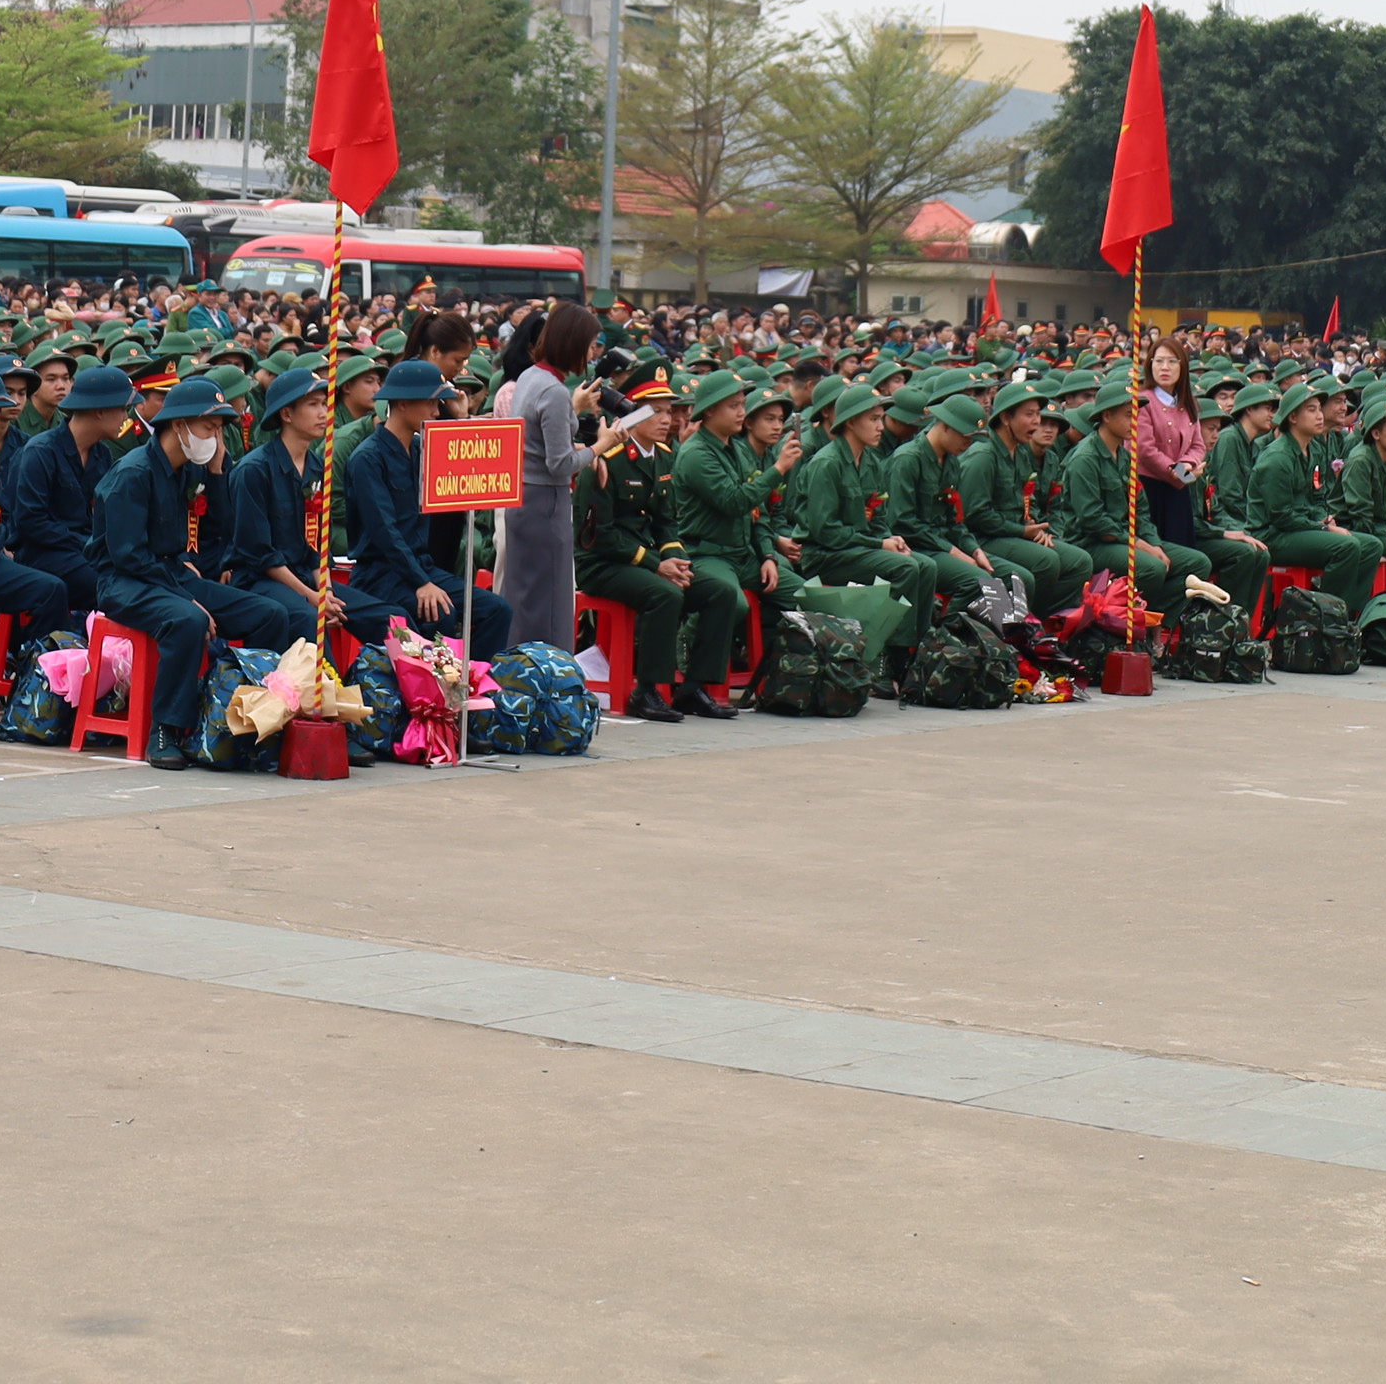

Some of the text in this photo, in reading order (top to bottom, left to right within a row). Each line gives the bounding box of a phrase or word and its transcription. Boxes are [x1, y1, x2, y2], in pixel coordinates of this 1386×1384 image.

[448, 433, 501, 460] SƯ ĐOÀN 361
[435, 467, 511, 496] QUÂN CHỦNG PK-KQ
